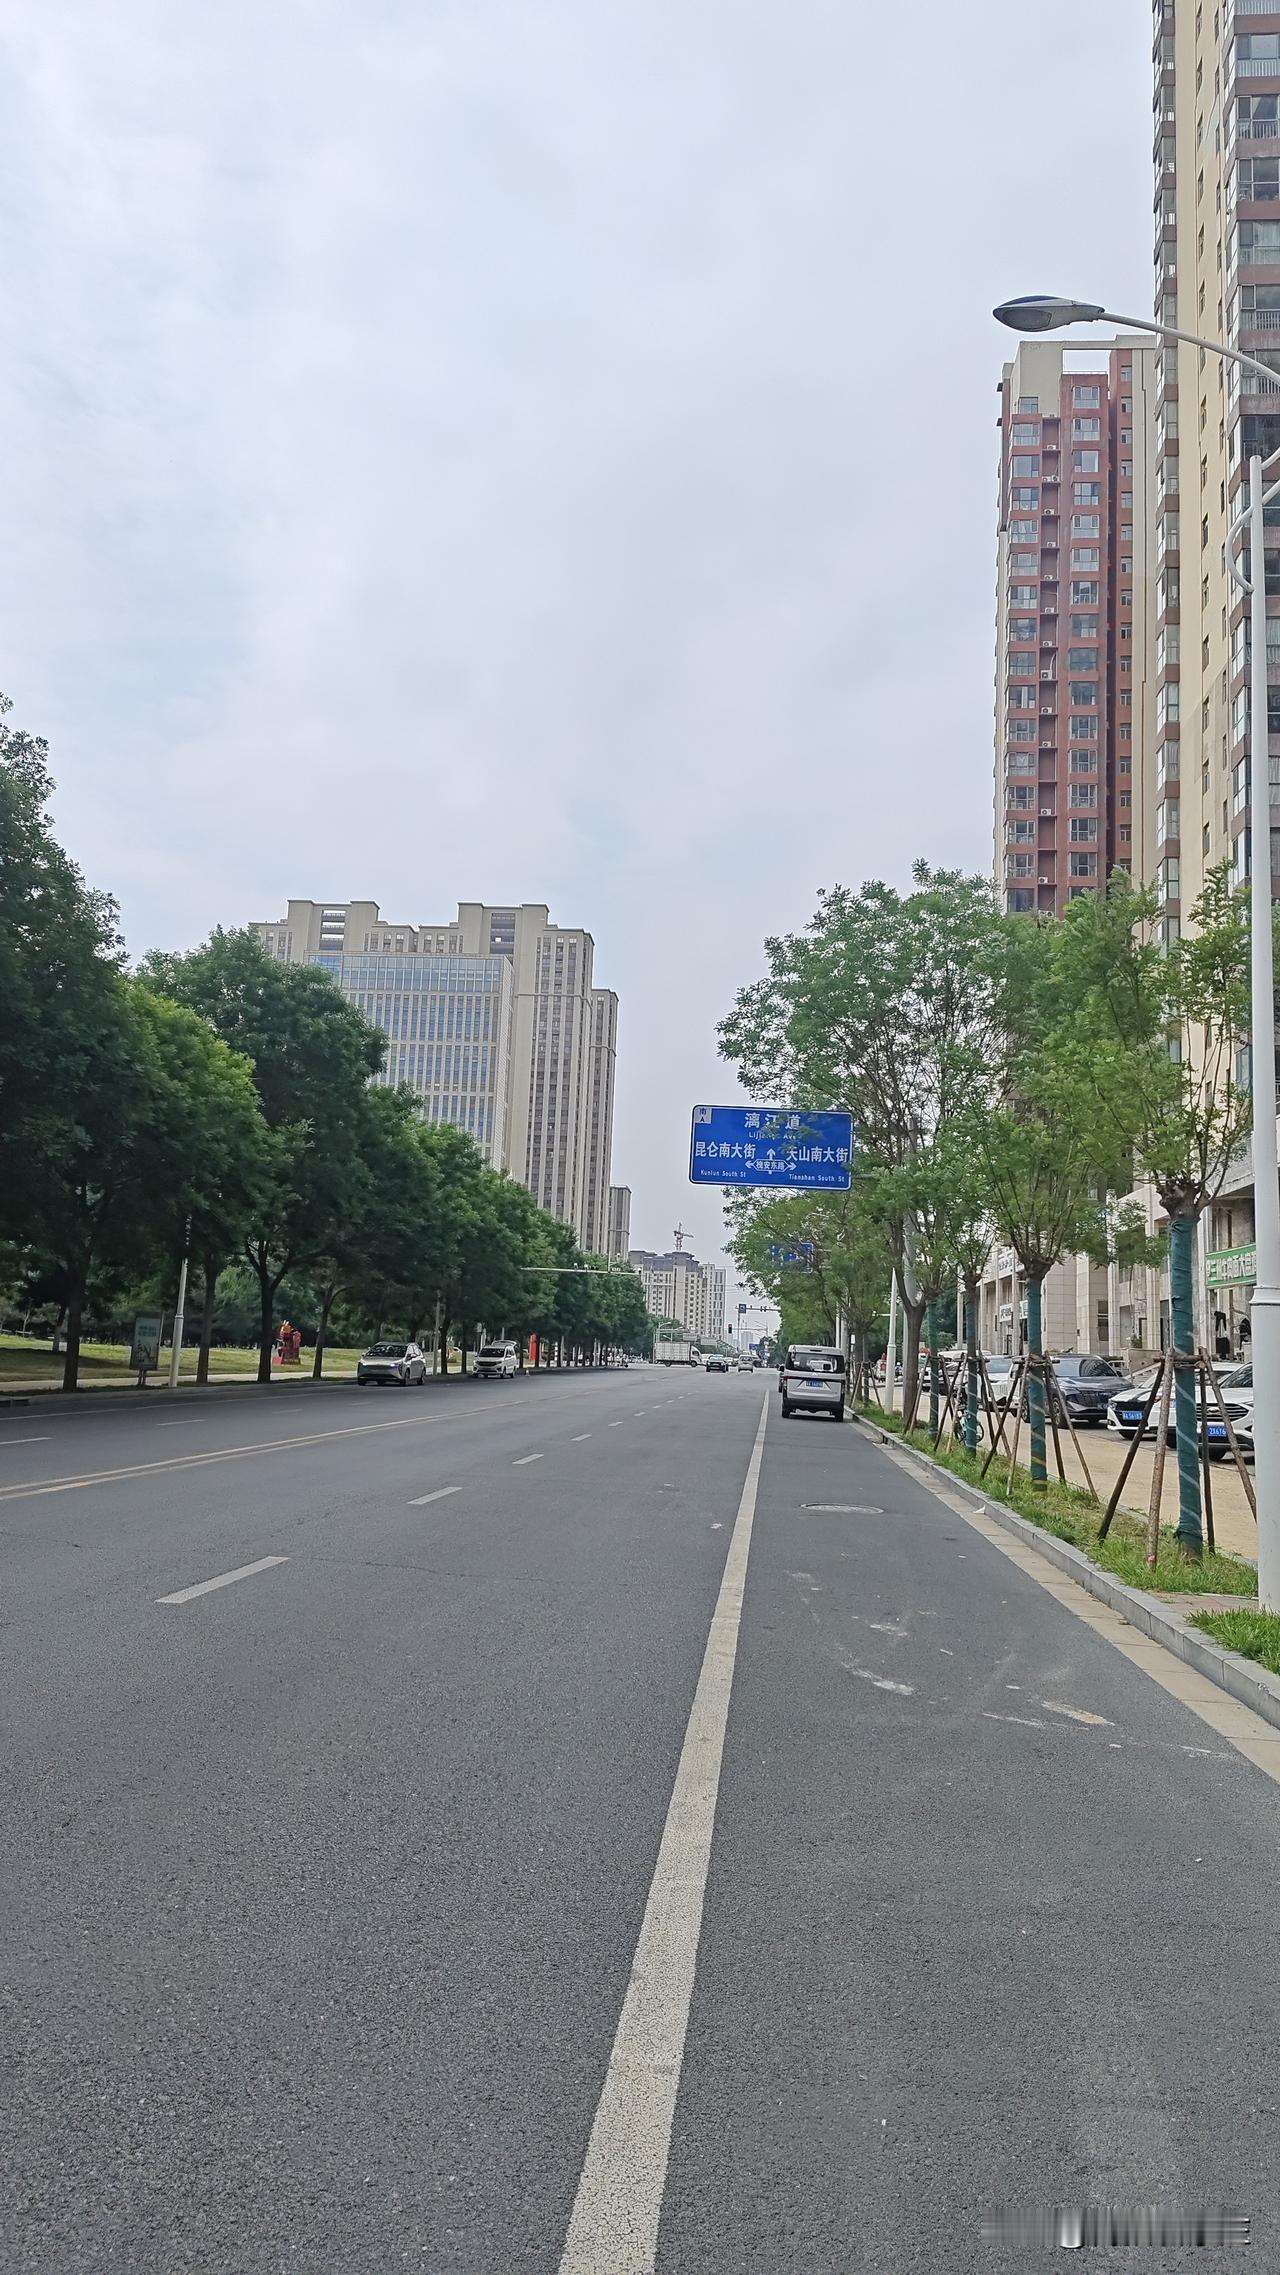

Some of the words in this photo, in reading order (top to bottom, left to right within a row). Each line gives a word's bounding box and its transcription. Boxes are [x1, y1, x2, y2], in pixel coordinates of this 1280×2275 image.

[744, 1112, 801, 1130] 漓江道
[695, 1141, 756, 1159] 昆仑南大街
[786, 1146, 849, 1163] 天山南大街
[701, 1169, 720, 1177] Kunlun
[788, 1173, 816, 1181] Tianshan
[817, 1174, 835, 1182] South
[838, 1175, 845, 1183] St
